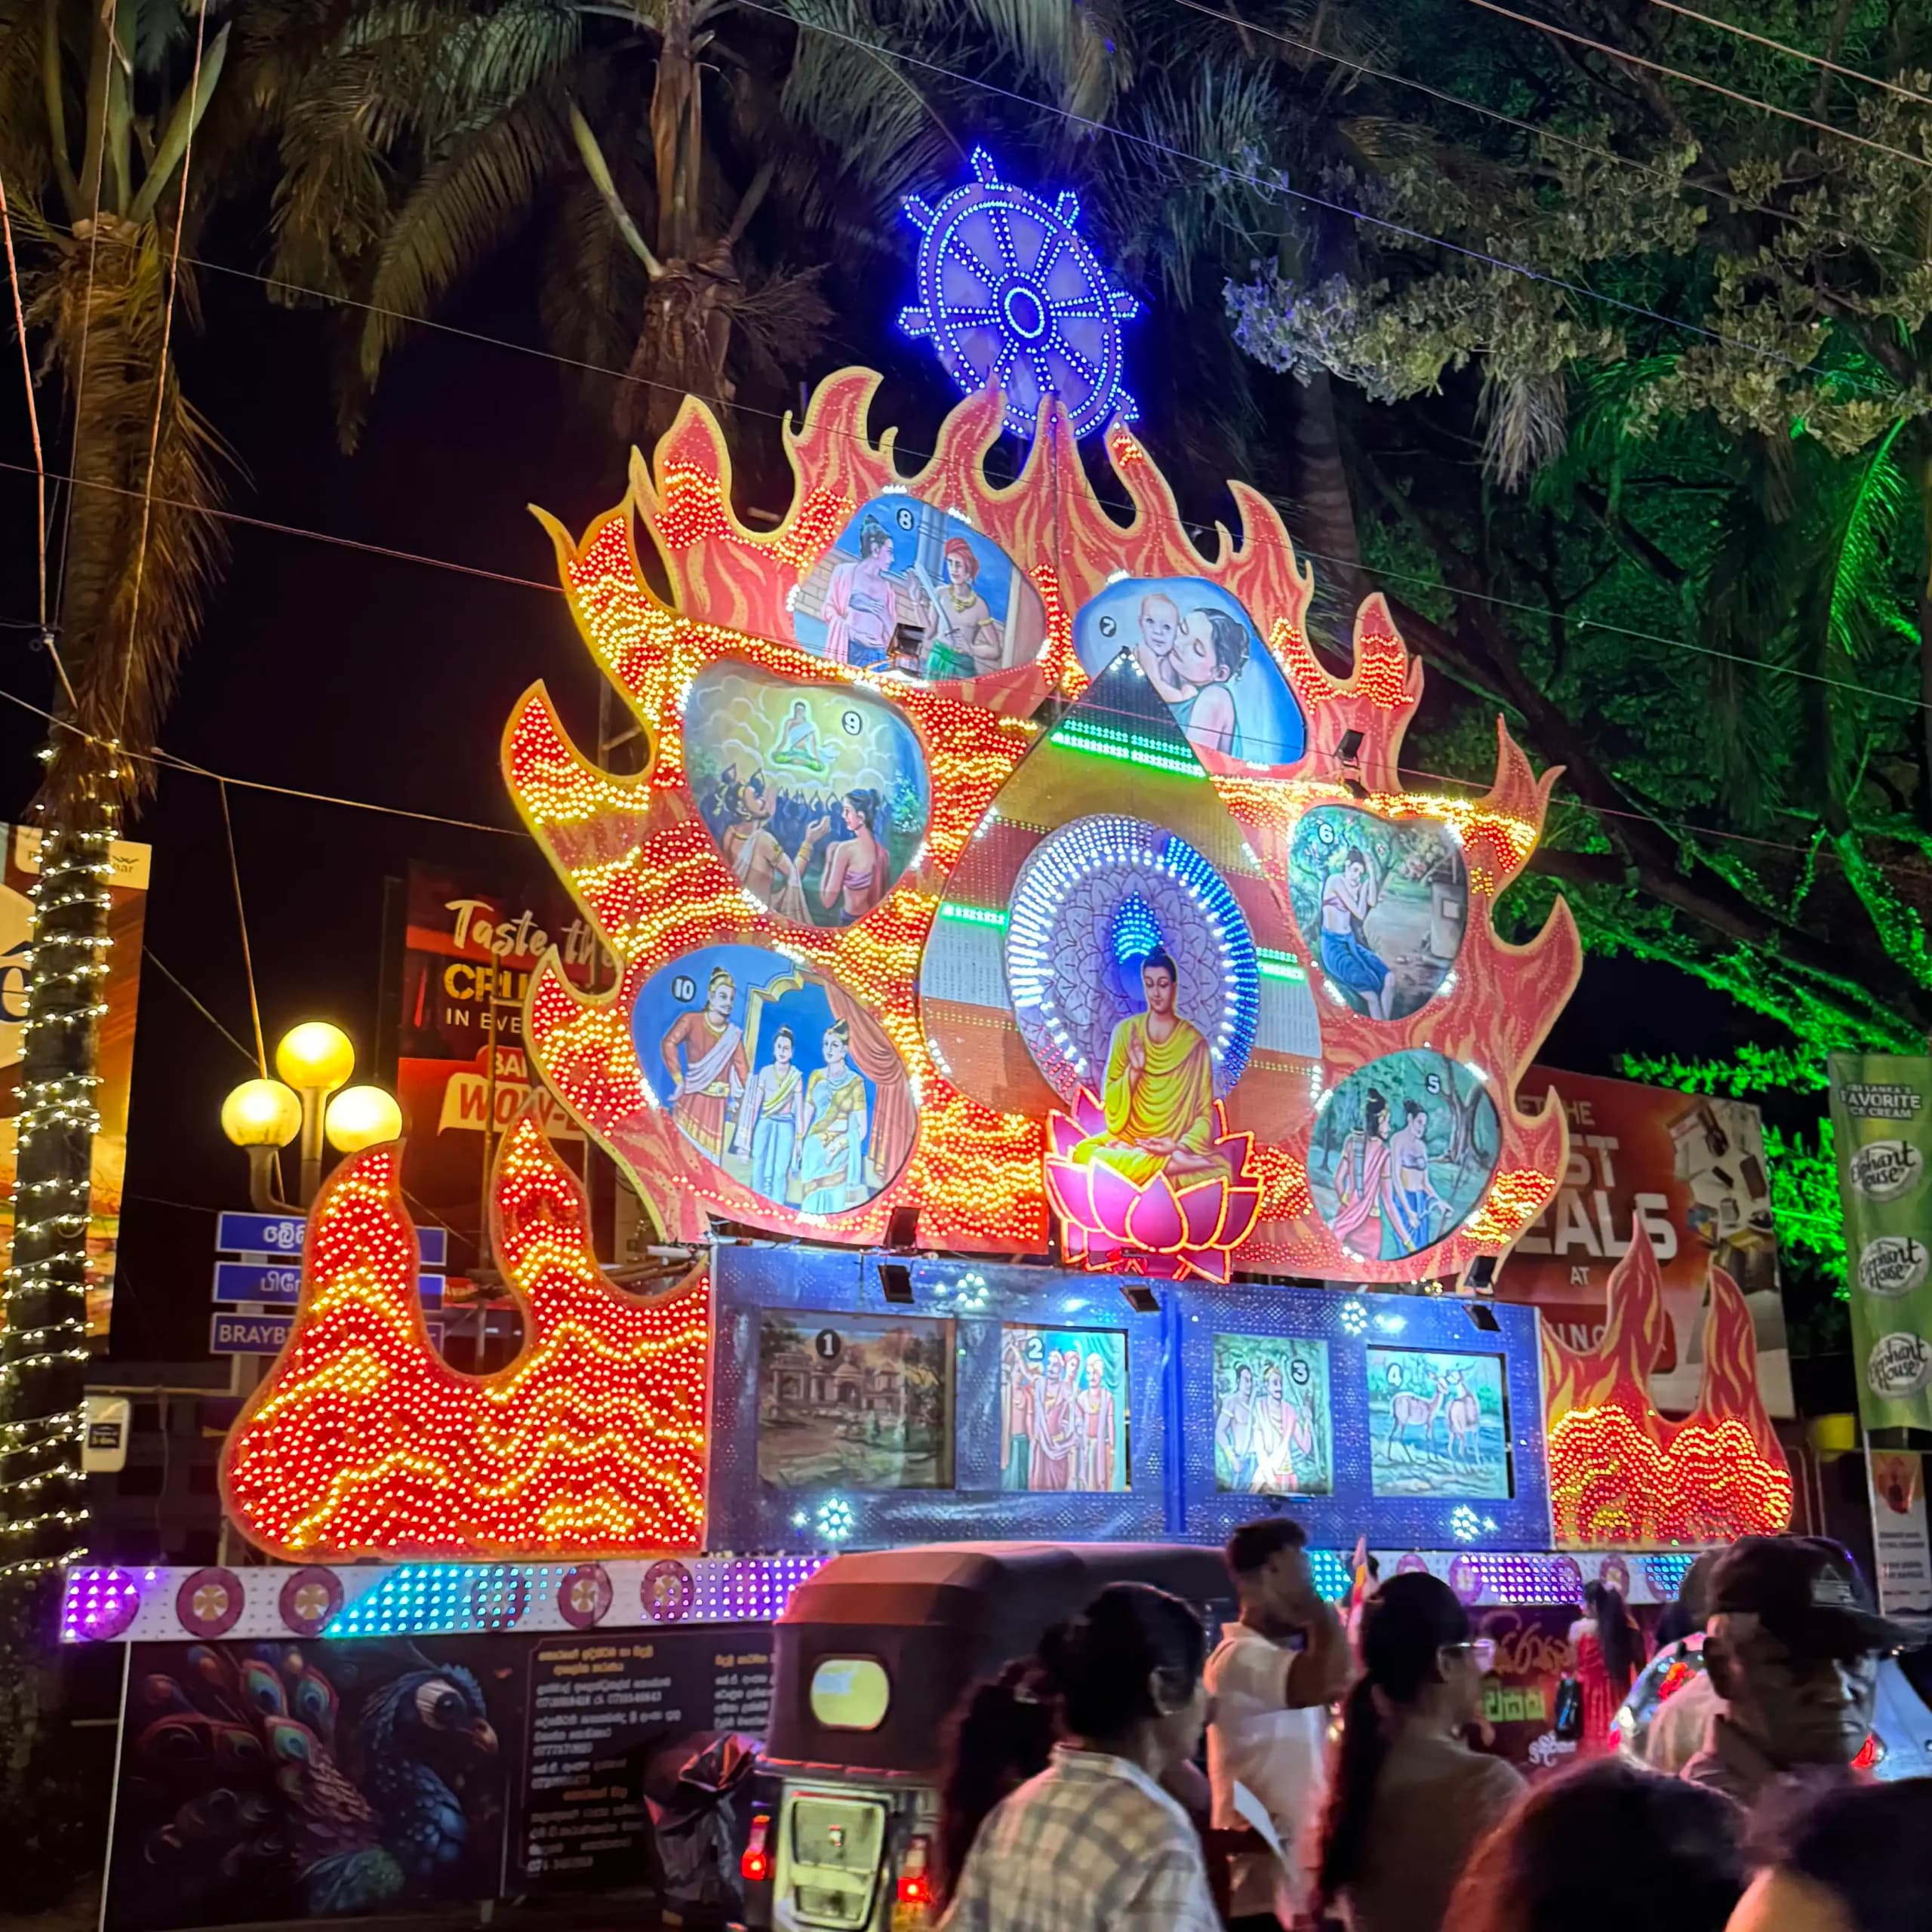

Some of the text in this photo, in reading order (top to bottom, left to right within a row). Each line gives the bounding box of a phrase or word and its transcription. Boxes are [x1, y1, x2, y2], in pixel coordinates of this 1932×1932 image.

[898, 509, 912, 530] 8
[1101, 617, 1115, 635] 7
[844, 712, 861, 734] 9
[445, 900, 547, 957] Taste
[675, 977, 695, 1001] 10
[446, 1008, 469, 1026] IN
[1426, 1074, 1440, 1094] 5
[1841, 1089, 1921, 1109] FAVORITE
[1565, 1100, 1595, 1125] HE
[1571, 1266, 1589, 1285] AT
[220, 1324, 285, 1344] BRAYB
[1027, 1337, 1044, 1359] 2
[1292, 1361, 1308, 1383] 3
[1387, 1364, 1402, 1386] 4
